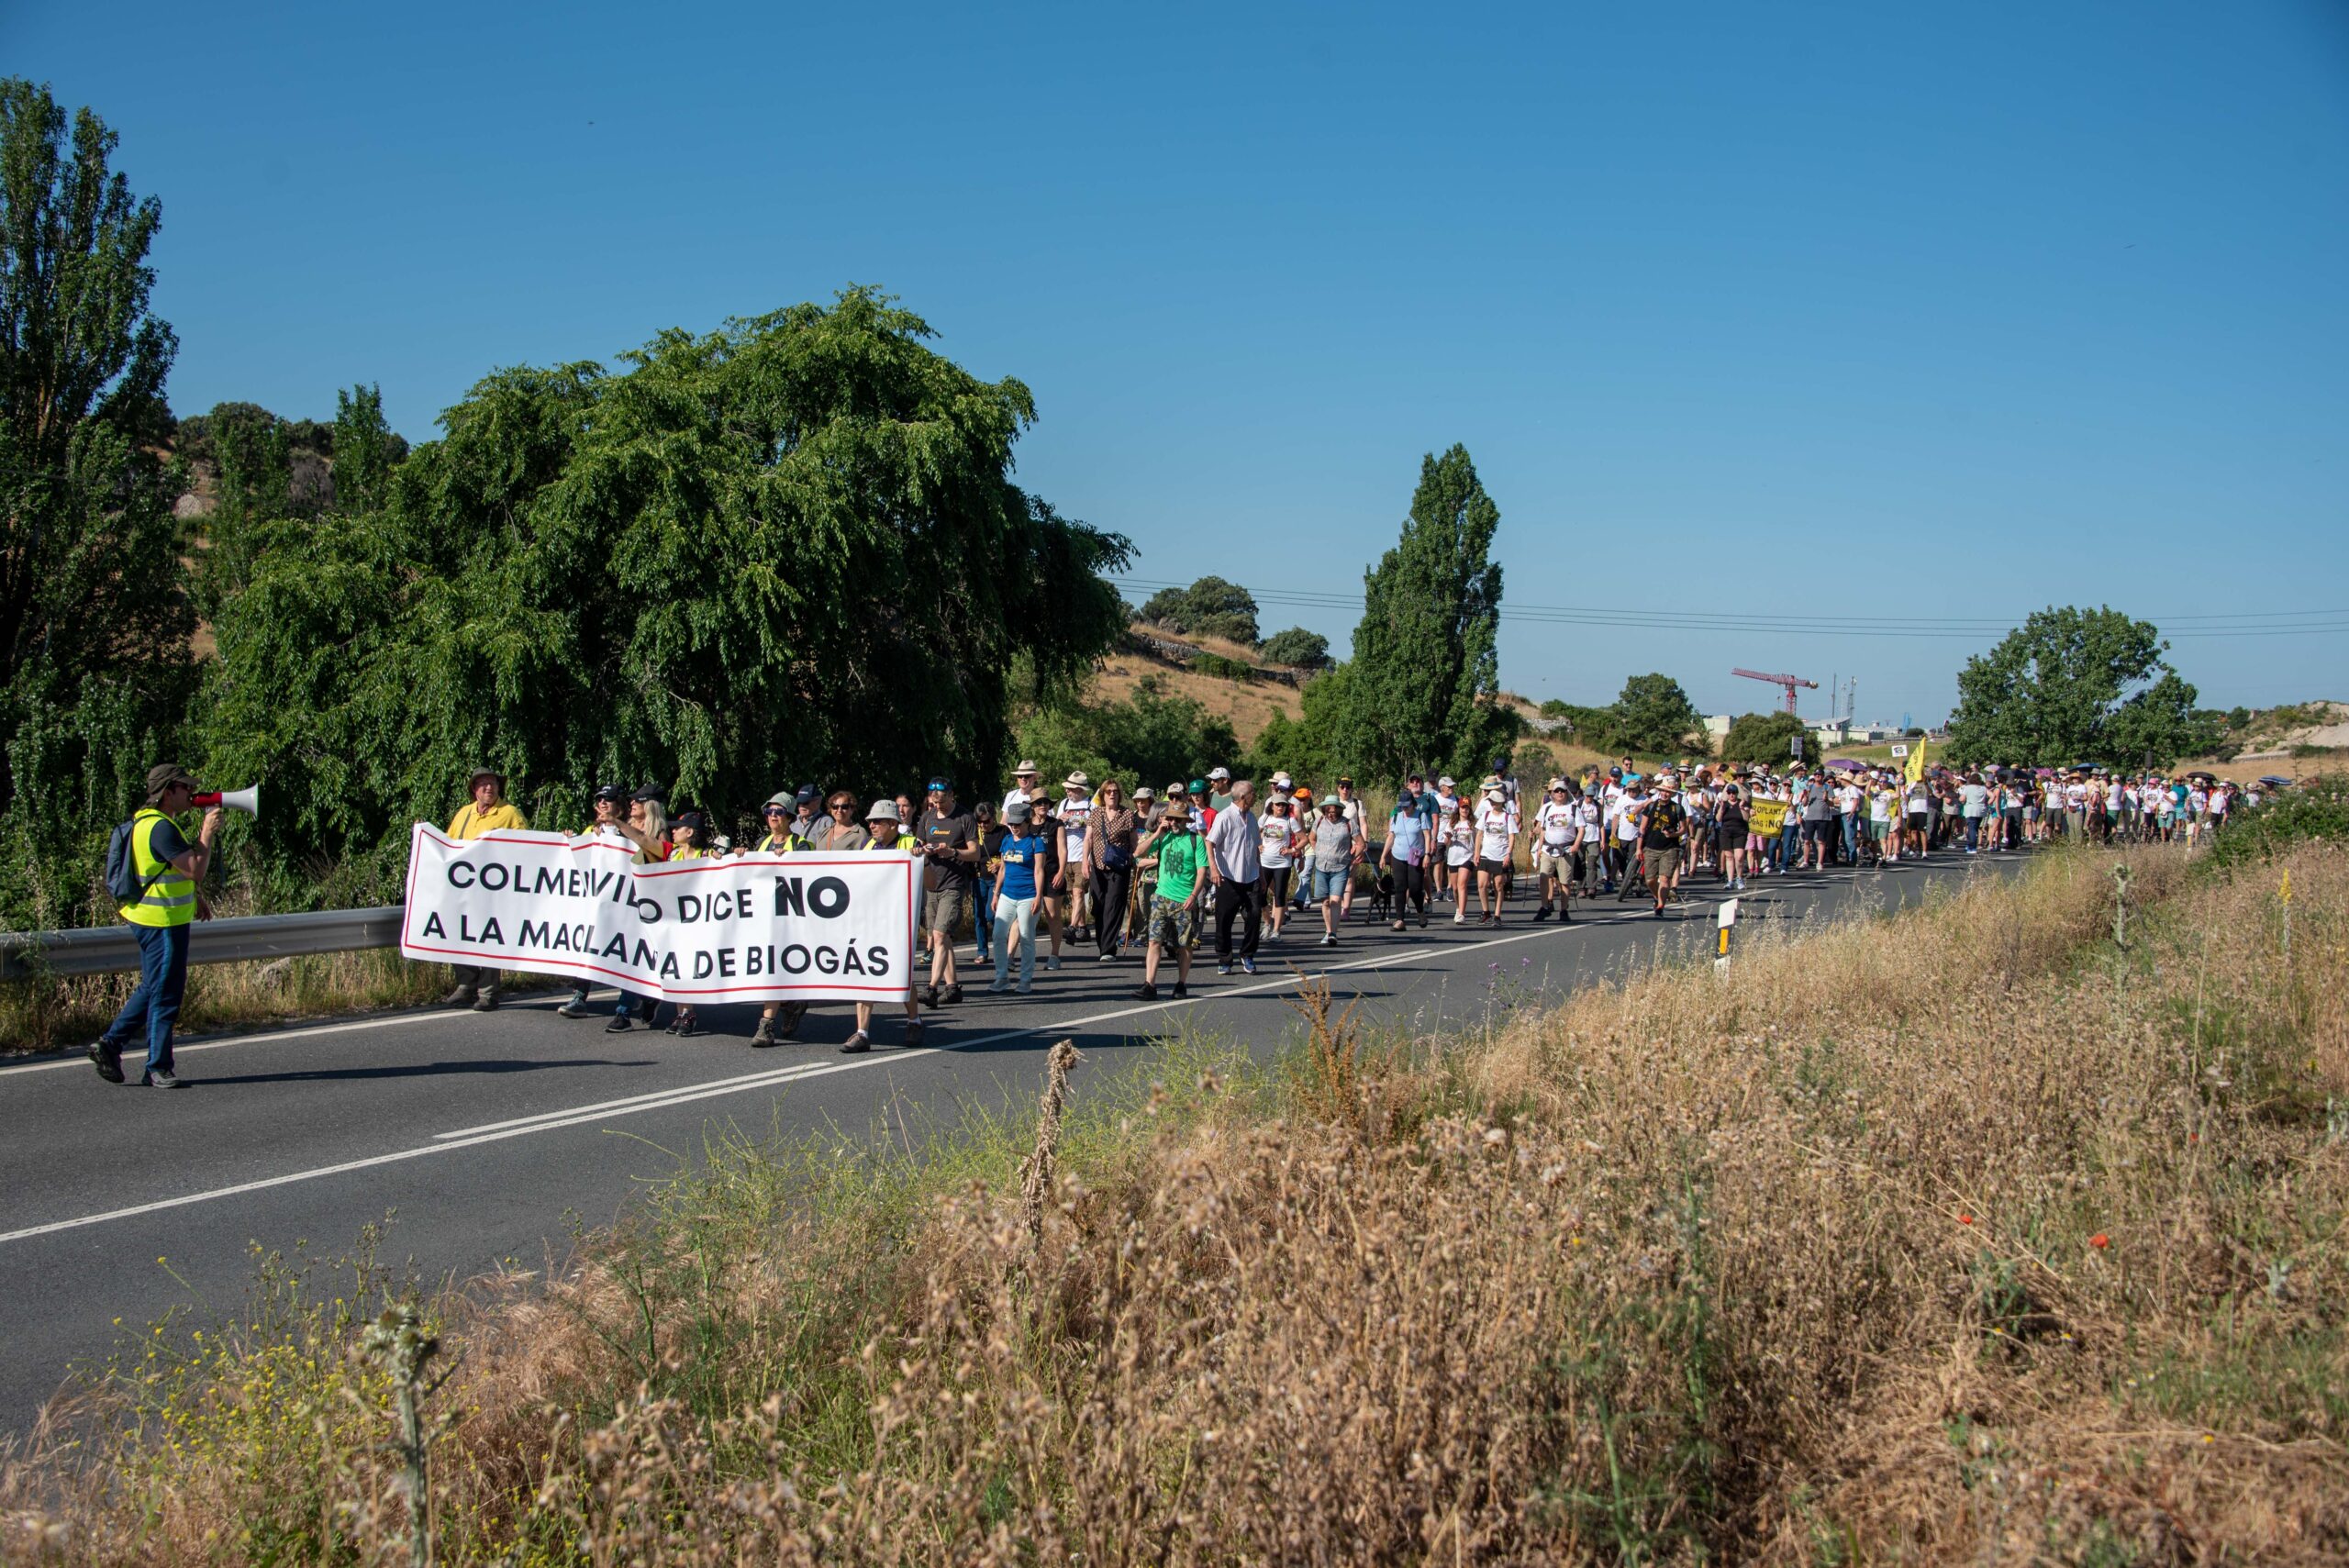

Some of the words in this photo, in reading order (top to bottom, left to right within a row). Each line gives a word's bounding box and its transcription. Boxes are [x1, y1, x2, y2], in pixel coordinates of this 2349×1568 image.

[677, 888, 753, 924] DICE
[774, 875, 851, 919] NO
[422, 911, 447, 940] A
[461, 914, 506, 945] LA
[693, 947, 736, 980] DE
[746, 938, 889, 977] BIOGÁS
